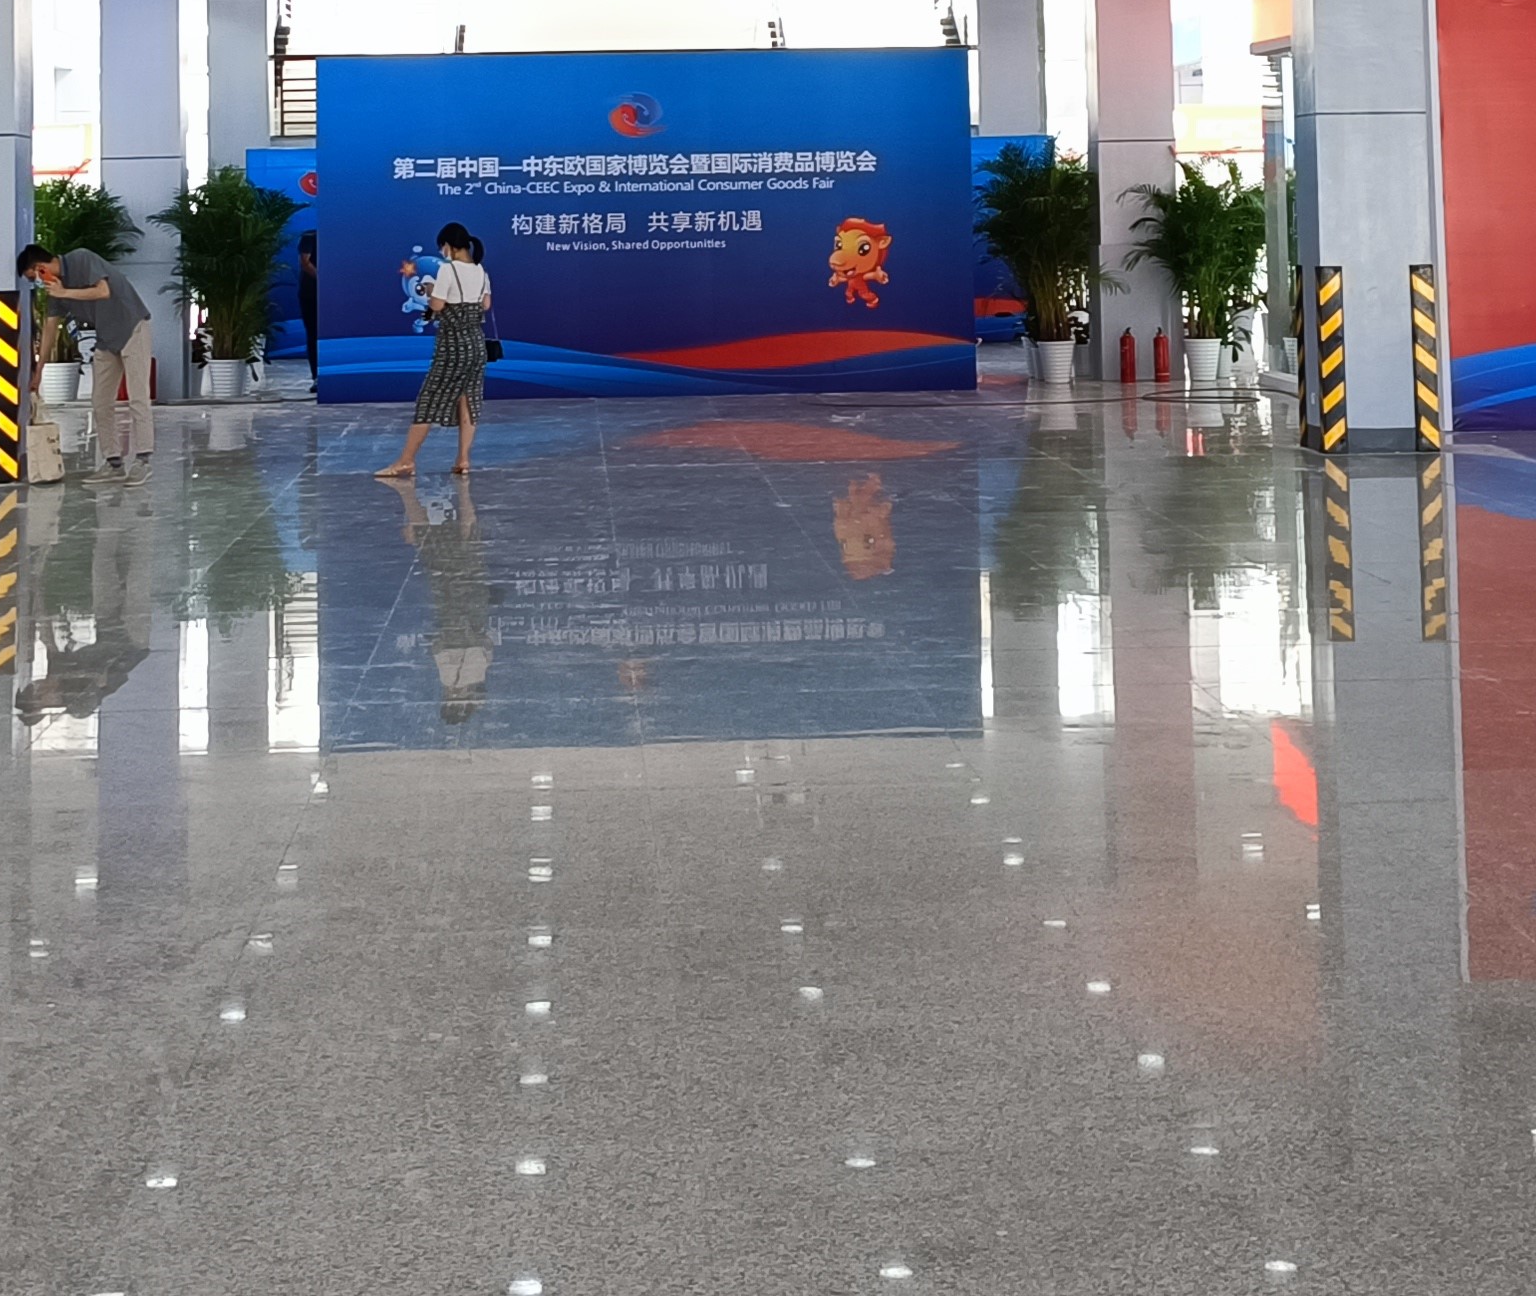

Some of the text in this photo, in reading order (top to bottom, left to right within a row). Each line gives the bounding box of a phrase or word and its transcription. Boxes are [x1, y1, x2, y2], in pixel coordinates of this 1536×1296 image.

[437, 177, 835, 196] The 2nd China-CEEC Expo & International Consumer Goods Fair
[511, 210, 763, 235] 构建新格局 共享新机遇
[546, 238, 726, 252] New Vision, Shared Opportunities
